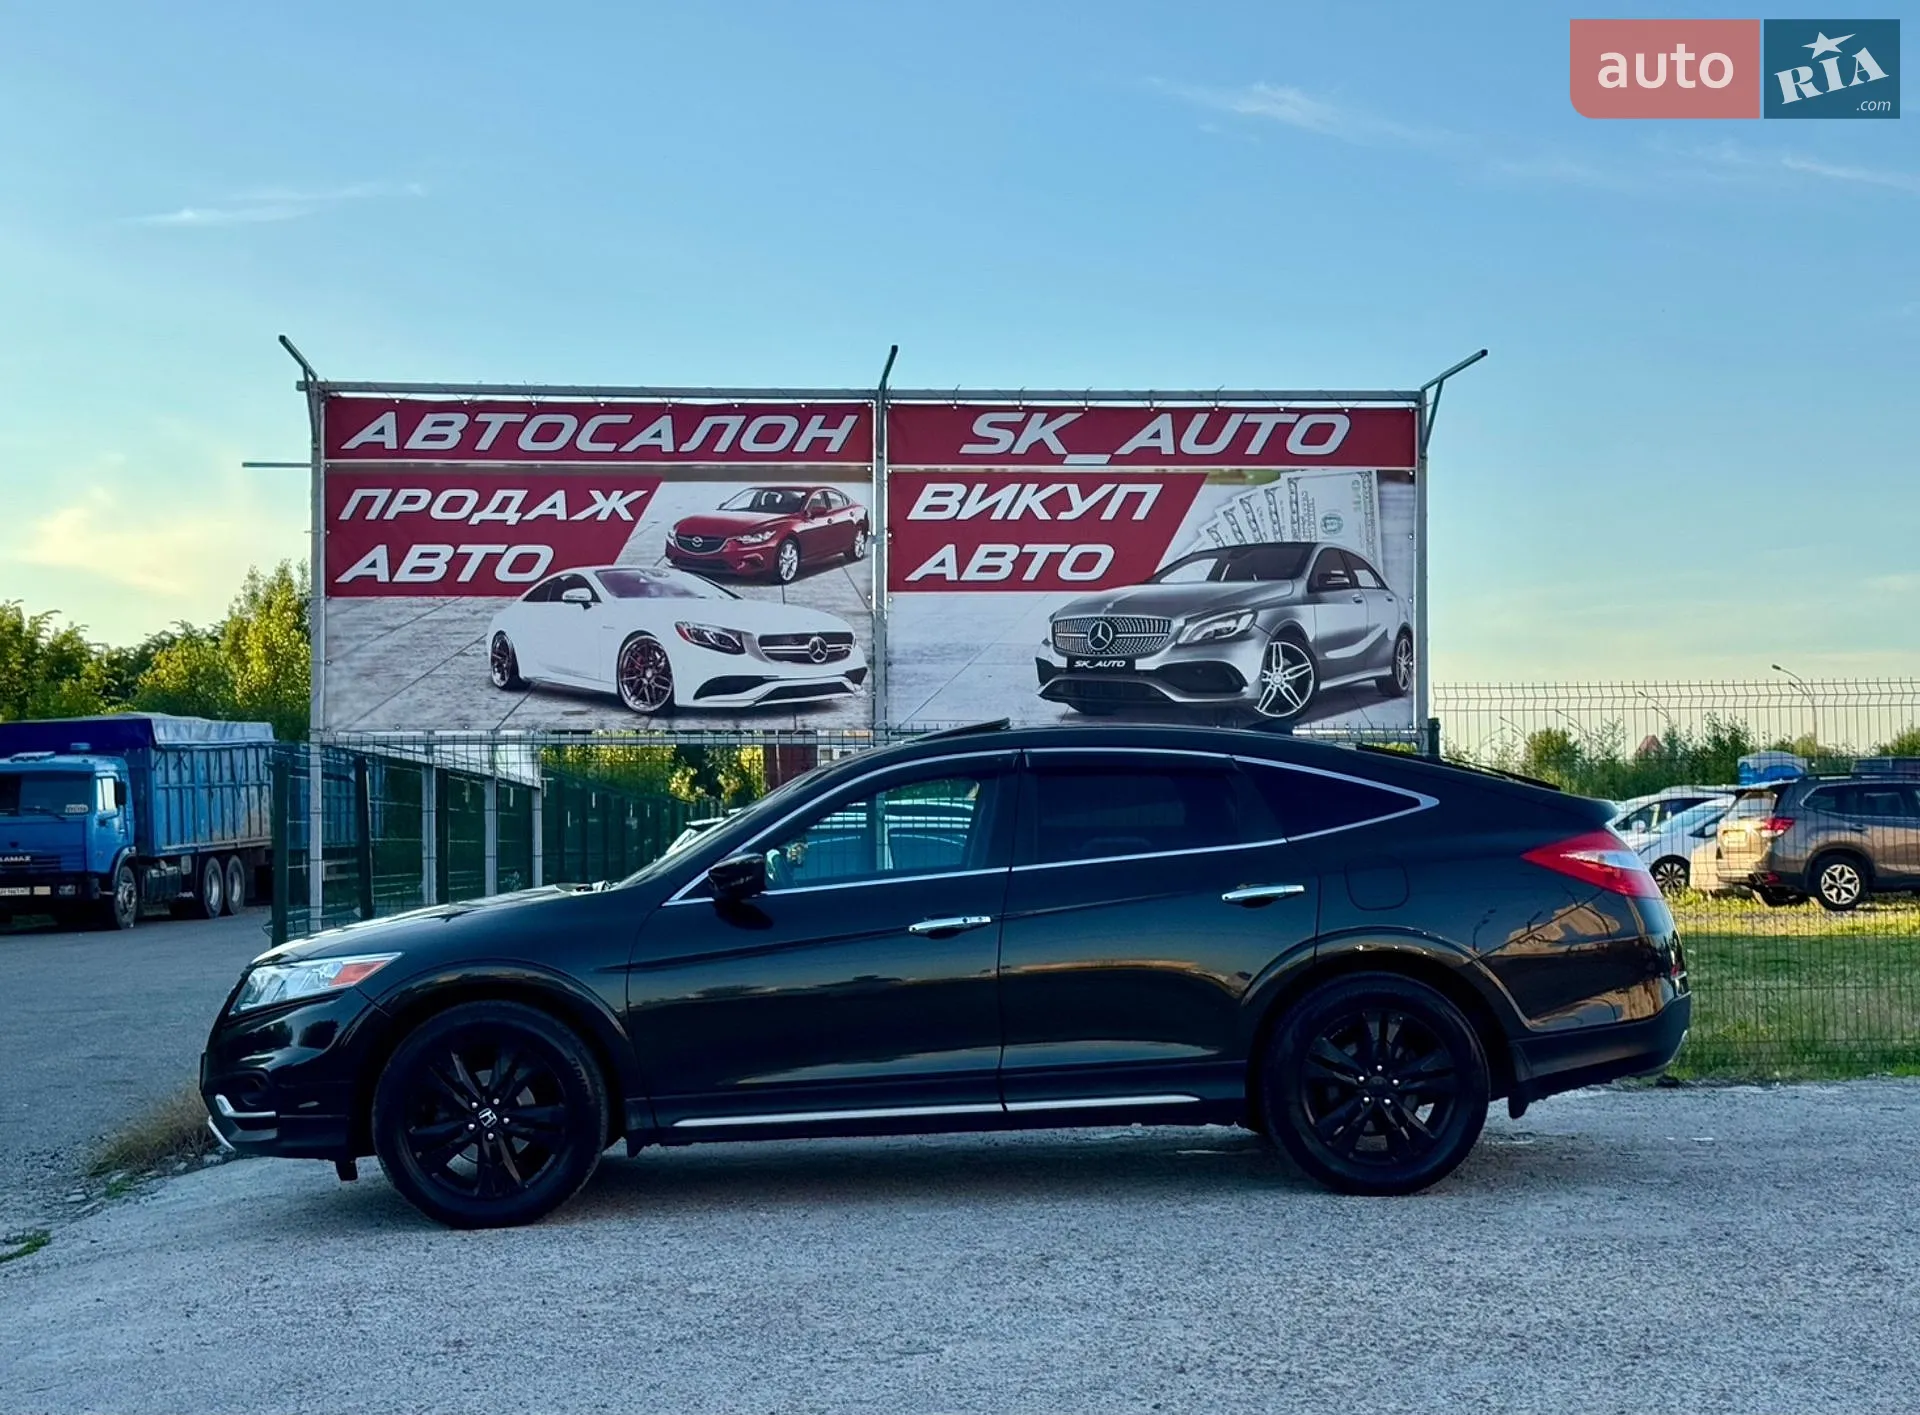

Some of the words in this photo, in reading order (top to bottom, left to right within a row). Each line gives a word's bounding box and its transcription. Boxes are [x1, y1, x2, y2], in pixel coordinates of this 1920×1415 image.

[340, 410, 859, 454] АВТОСАЛОН
[958, 412, 1351, 465] SK_AUTO
[338, 487, 649, 526] ПРОДАЖ
[906, 482, 1164, 521] ВИКУП
[335, 543, 555, 584] АВТО
[905, 543, 1116, 582] АВТО
[1073, 660, 1126, 669] SK_AUTO
